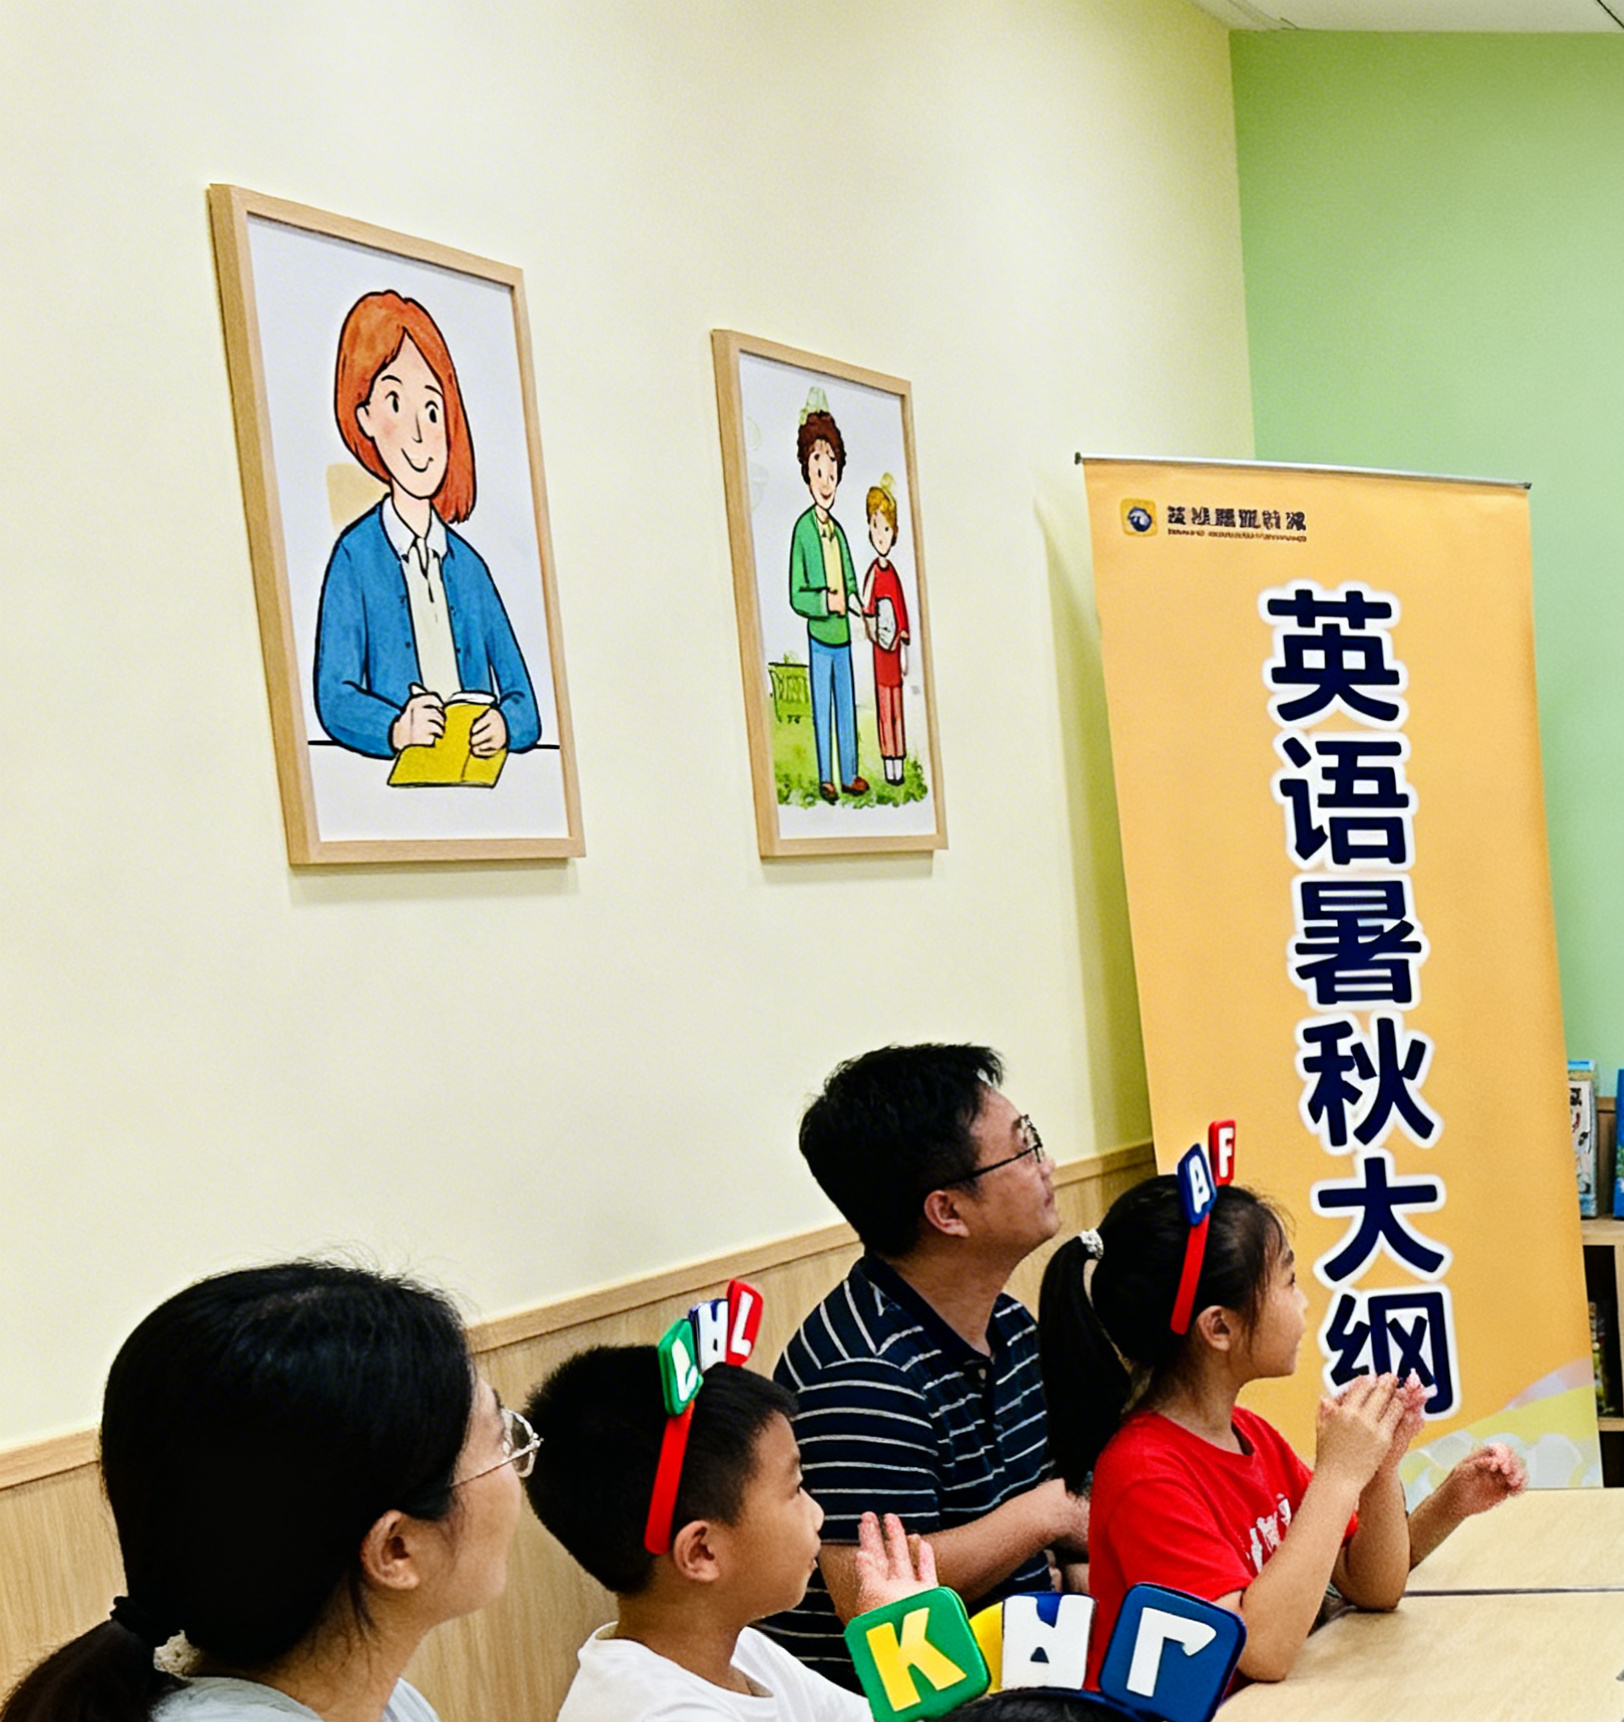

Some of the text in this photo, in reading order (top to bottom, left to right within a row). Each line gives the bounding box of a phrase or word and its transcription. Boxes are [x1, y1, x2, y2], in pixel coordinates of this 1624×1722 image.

[1266, 588, 1455, 1415] 英语暑秋大纲
[865, 1606, 967, 1712] K
